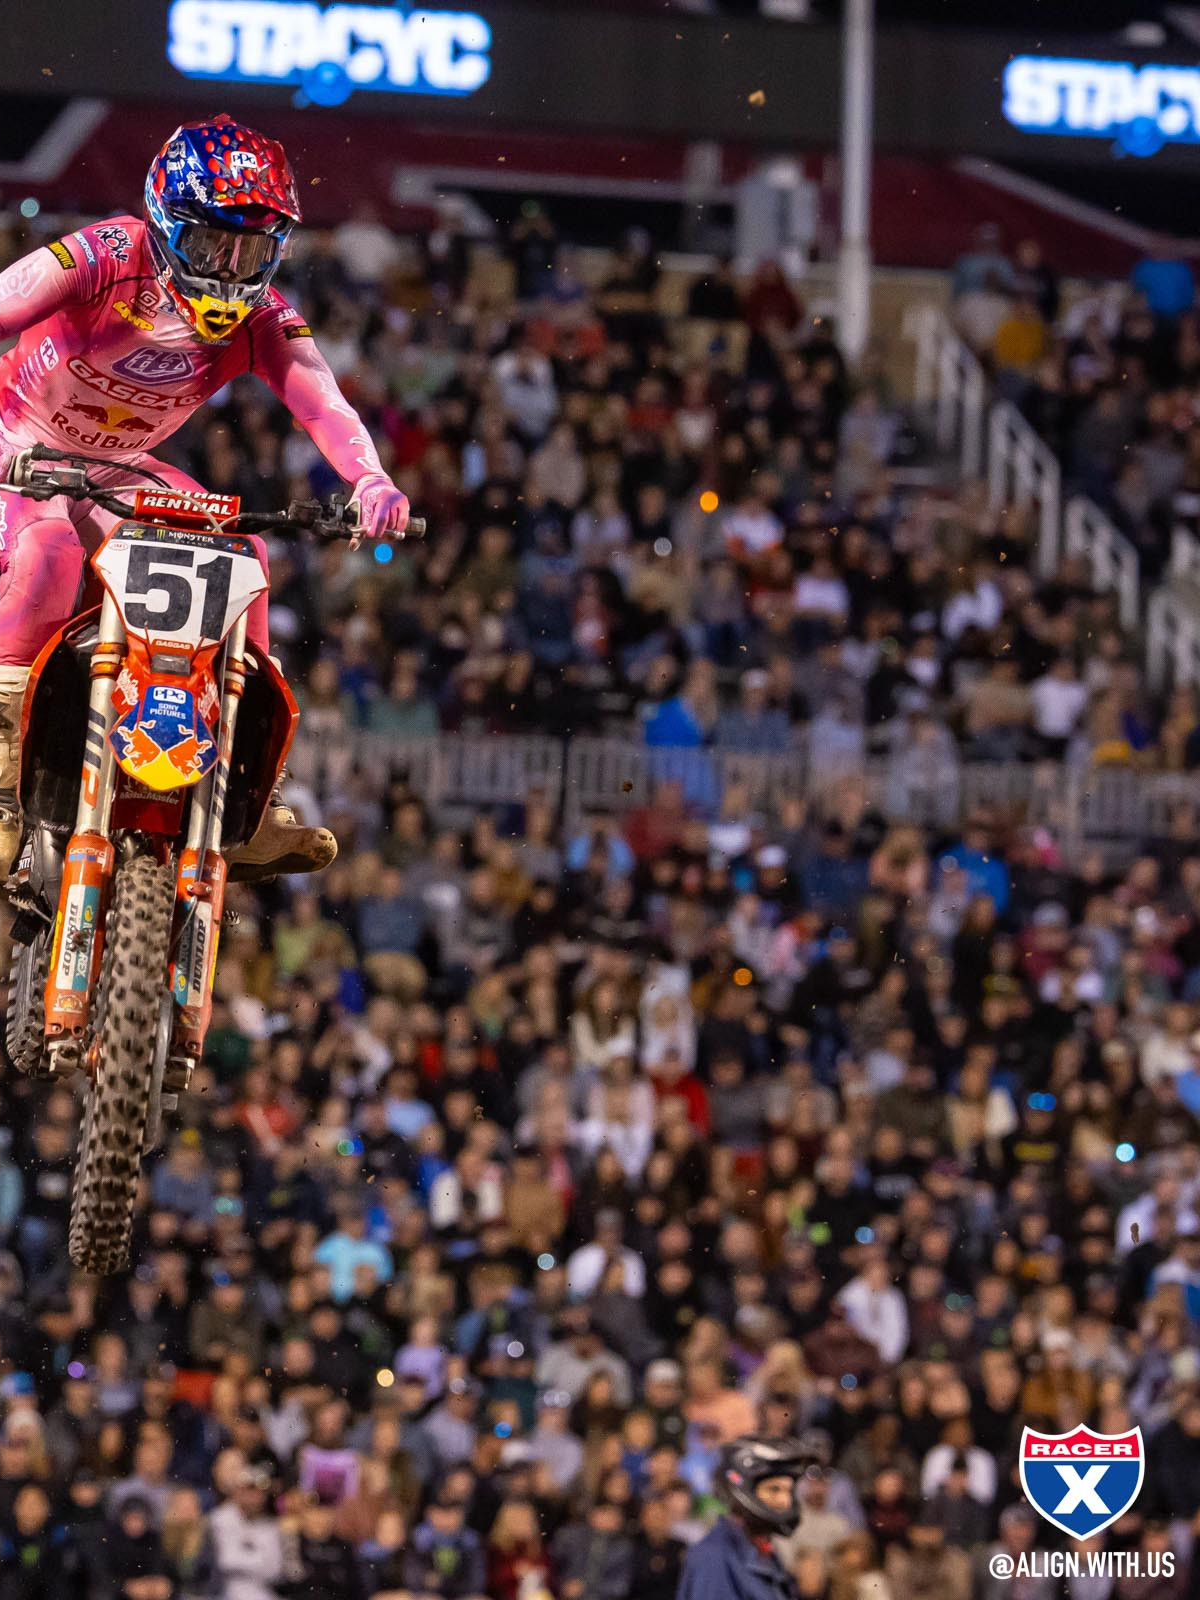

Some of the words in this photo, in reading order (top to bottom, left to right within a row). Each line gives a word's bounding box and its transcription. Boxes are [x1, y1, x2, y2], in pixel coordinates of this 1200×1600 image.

[232, 153, 257, 165] PPG
[51, 412, 102, 447] Red
[100, 436, 150, 449] Bull
[143, 496, 232, 515] RENTHAL
[168, 532, 215, 543] MONSTER
[124, 544, 233, 641] 51
[155, 641, 191, 650] GASGAS
[150, 708, 186, 719] PICTURES
[192, 919, 207, 992] DUNLOP
